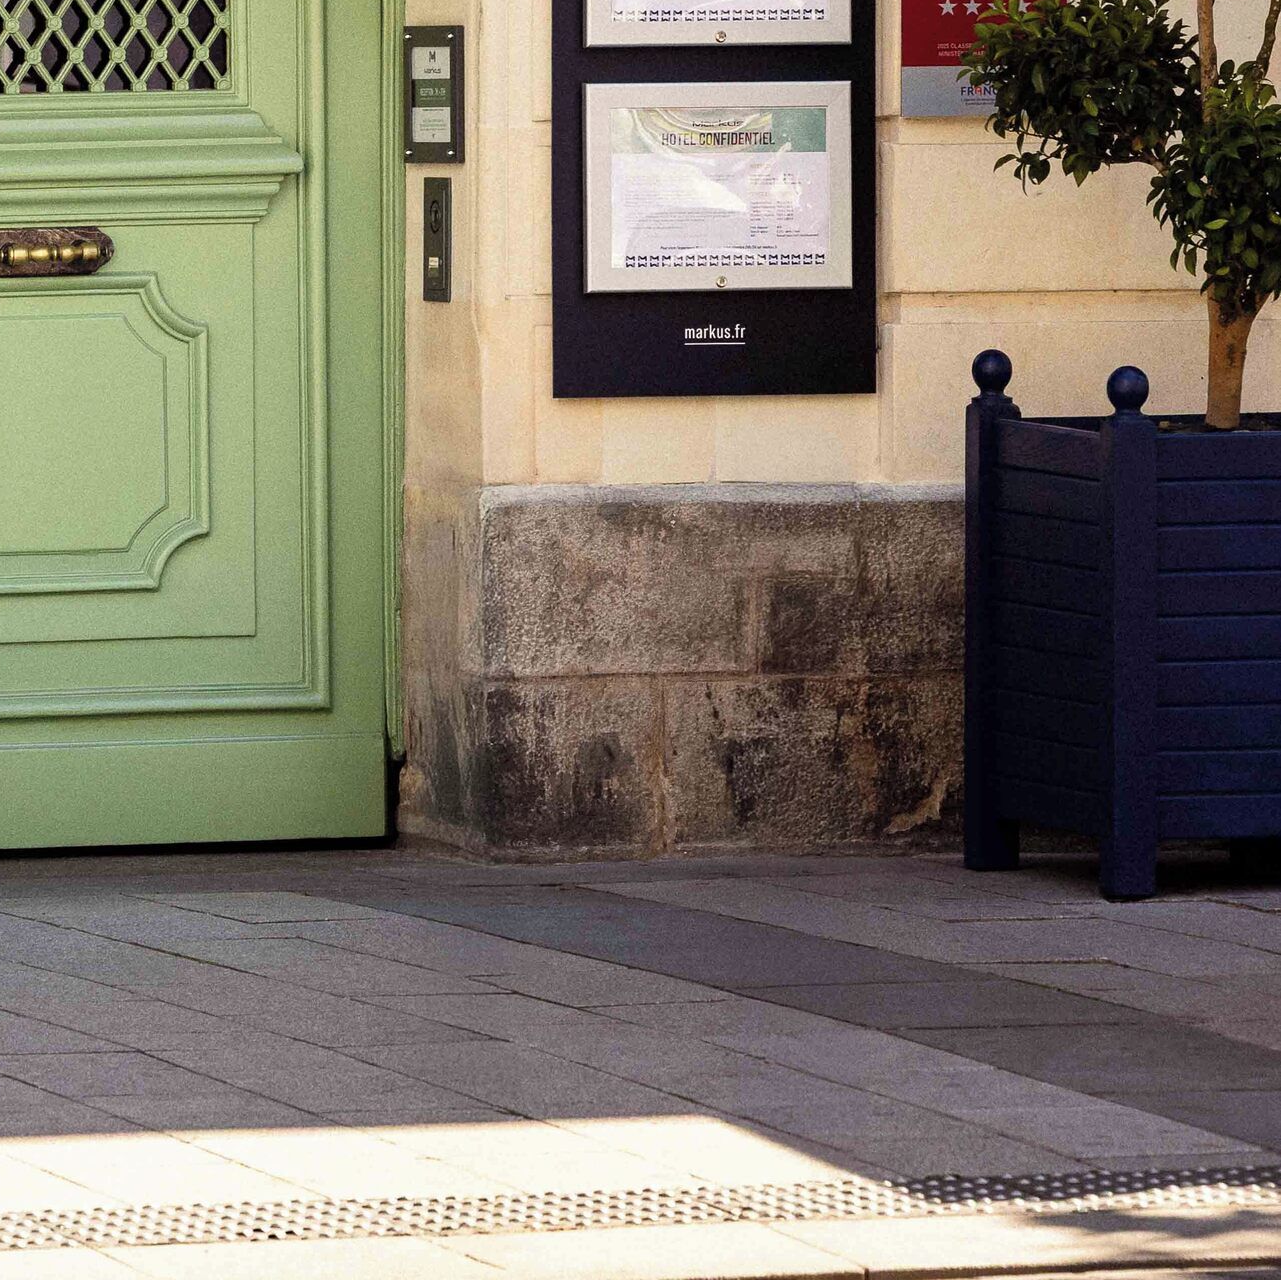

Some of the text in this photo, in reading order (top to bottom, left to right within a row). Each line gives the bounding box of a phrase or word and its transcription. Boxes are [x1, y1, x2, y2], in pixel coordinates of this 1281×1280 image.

[961, 86, 998, 96] FRANC
[699, 131, 776, 146] CONFIDENTIEL
[684, 323, 746, 339] markus.fr
